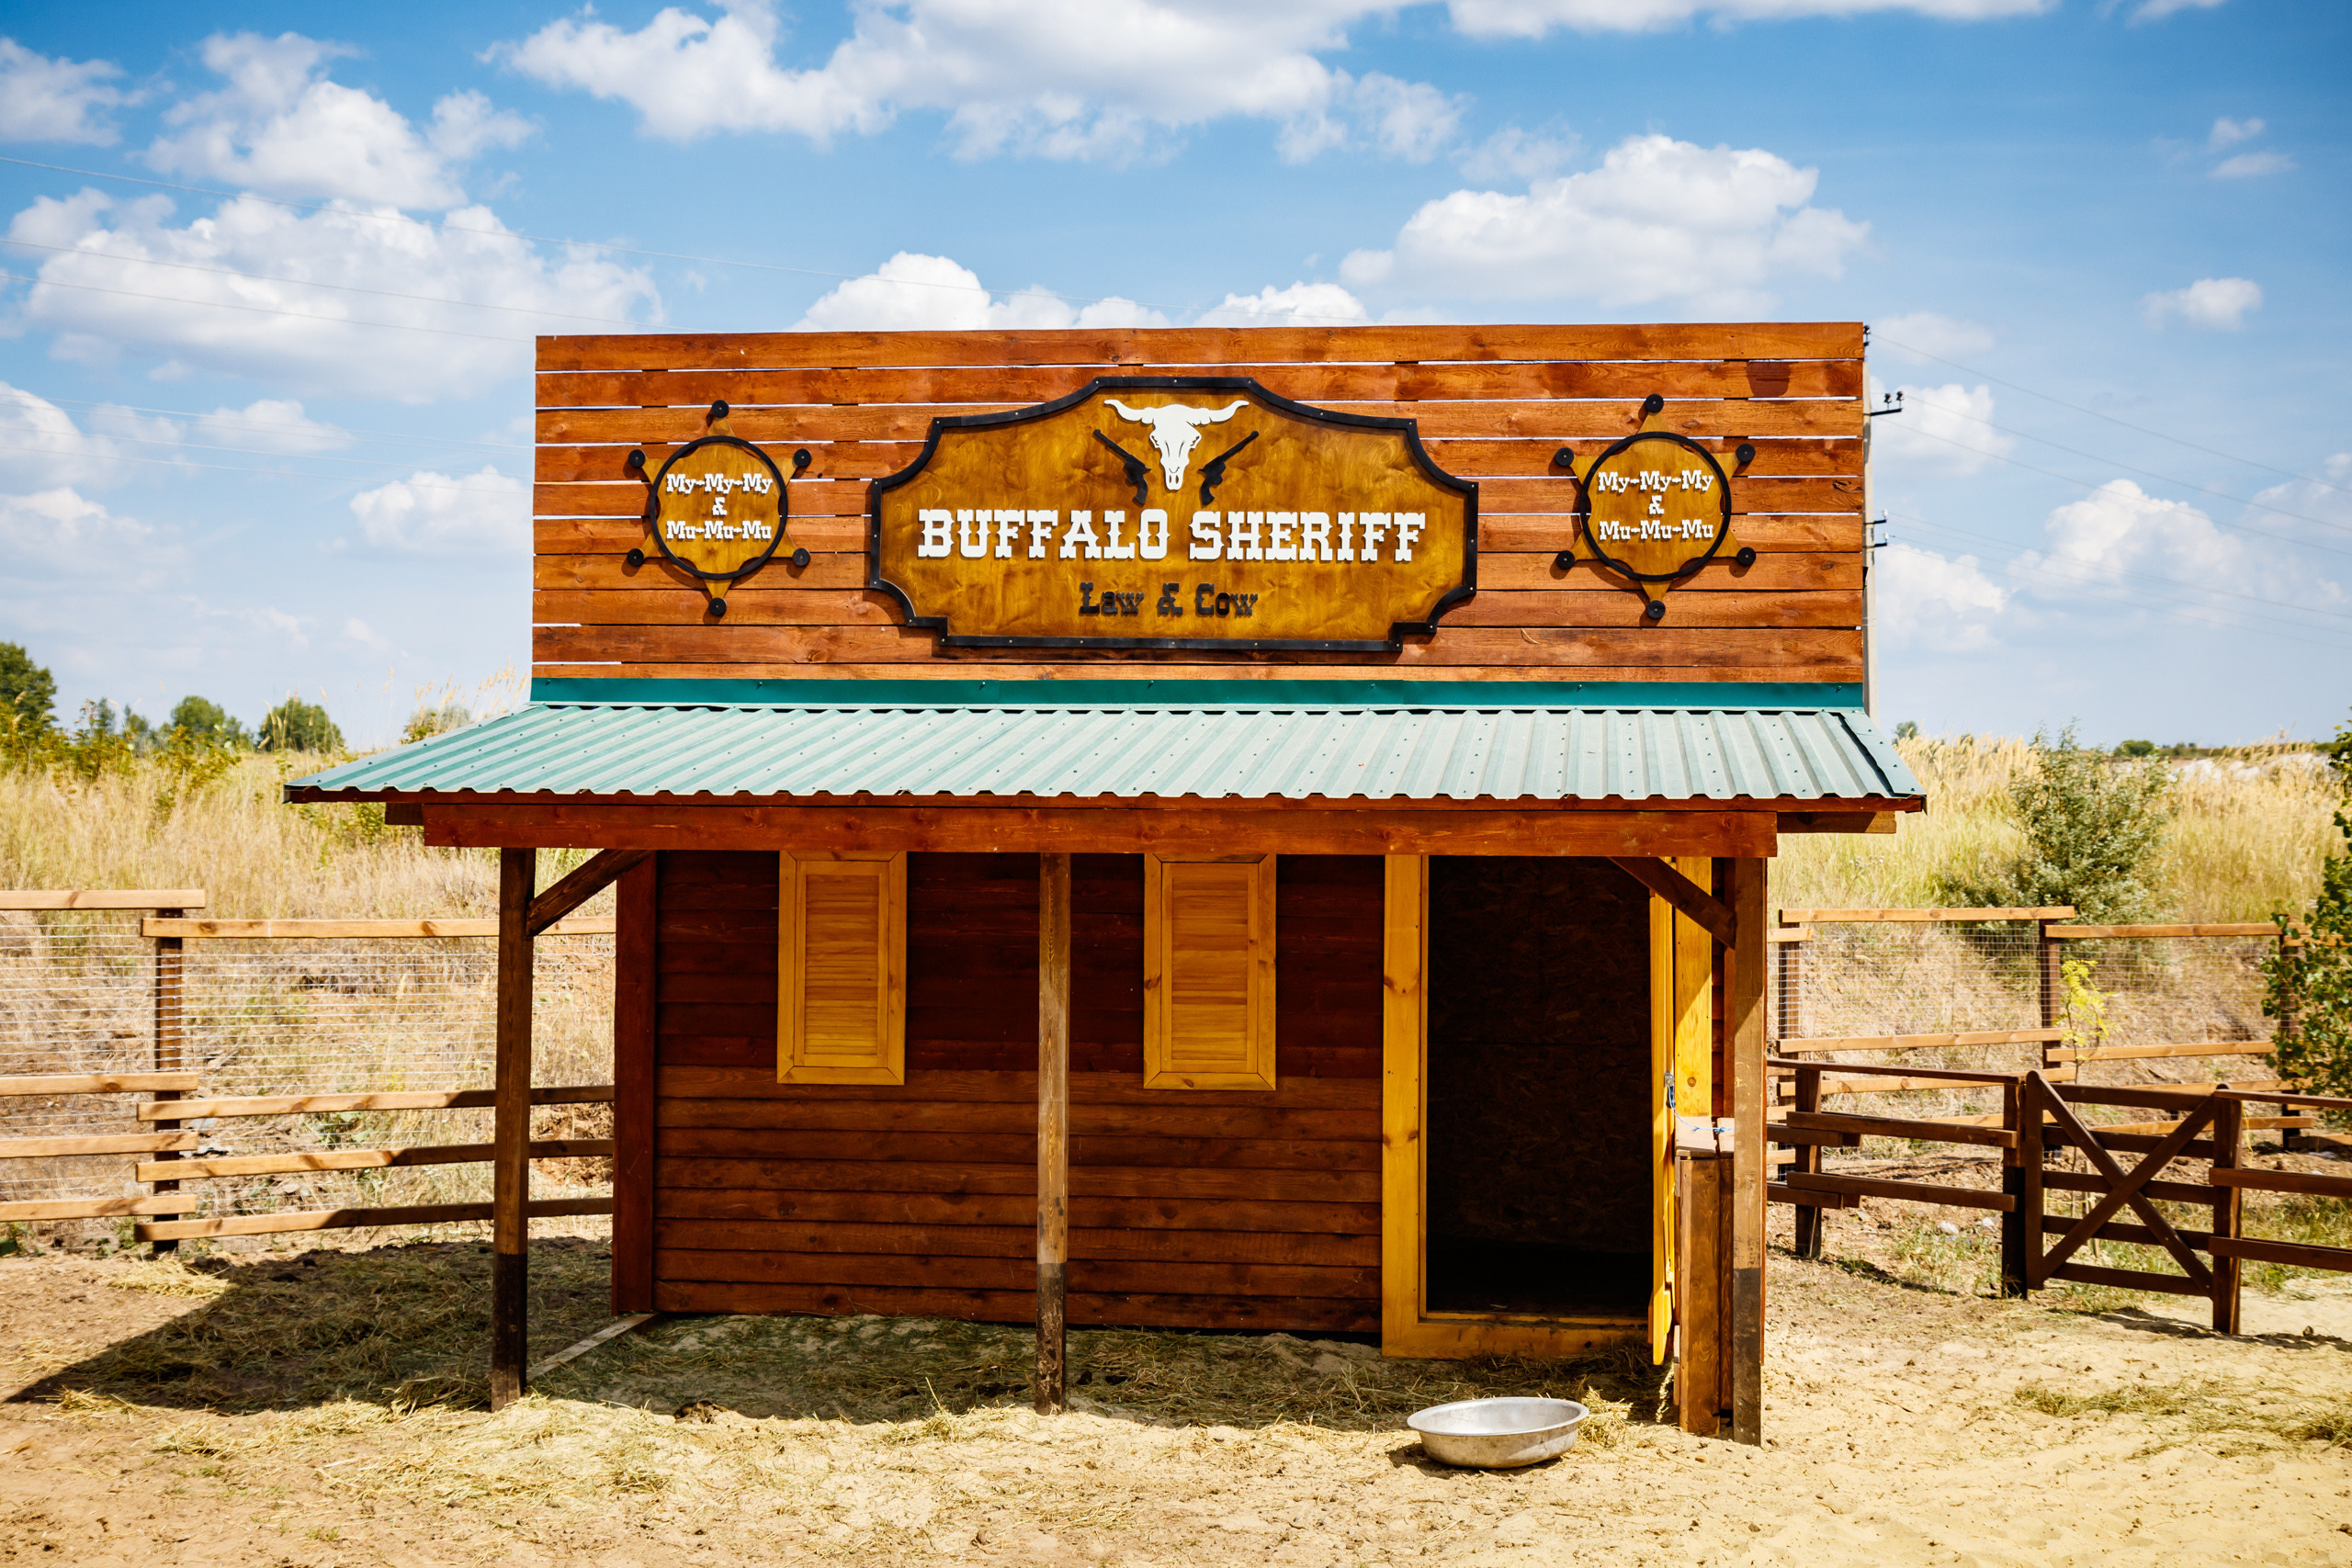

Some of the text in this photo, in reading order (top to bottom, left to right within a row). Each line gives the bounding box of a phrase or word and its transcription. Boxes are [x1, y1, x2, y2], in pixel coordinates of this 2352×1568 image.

[666, 473, 774, 494] My-My-My
[1598, 469, 1714, 493] My-My-My
[712, 496, 728, 515] &
[1649, 495, 1665, 515] &
[666, 520, 773, 540] Mu-Mu-Mu
[918, 509, 1426, 562] BUFFALO SHERIFF
[1599, 519, 1714, 540] Mu-Mu-Mu
[1080, 581, 1259, 616] Law & Cow
